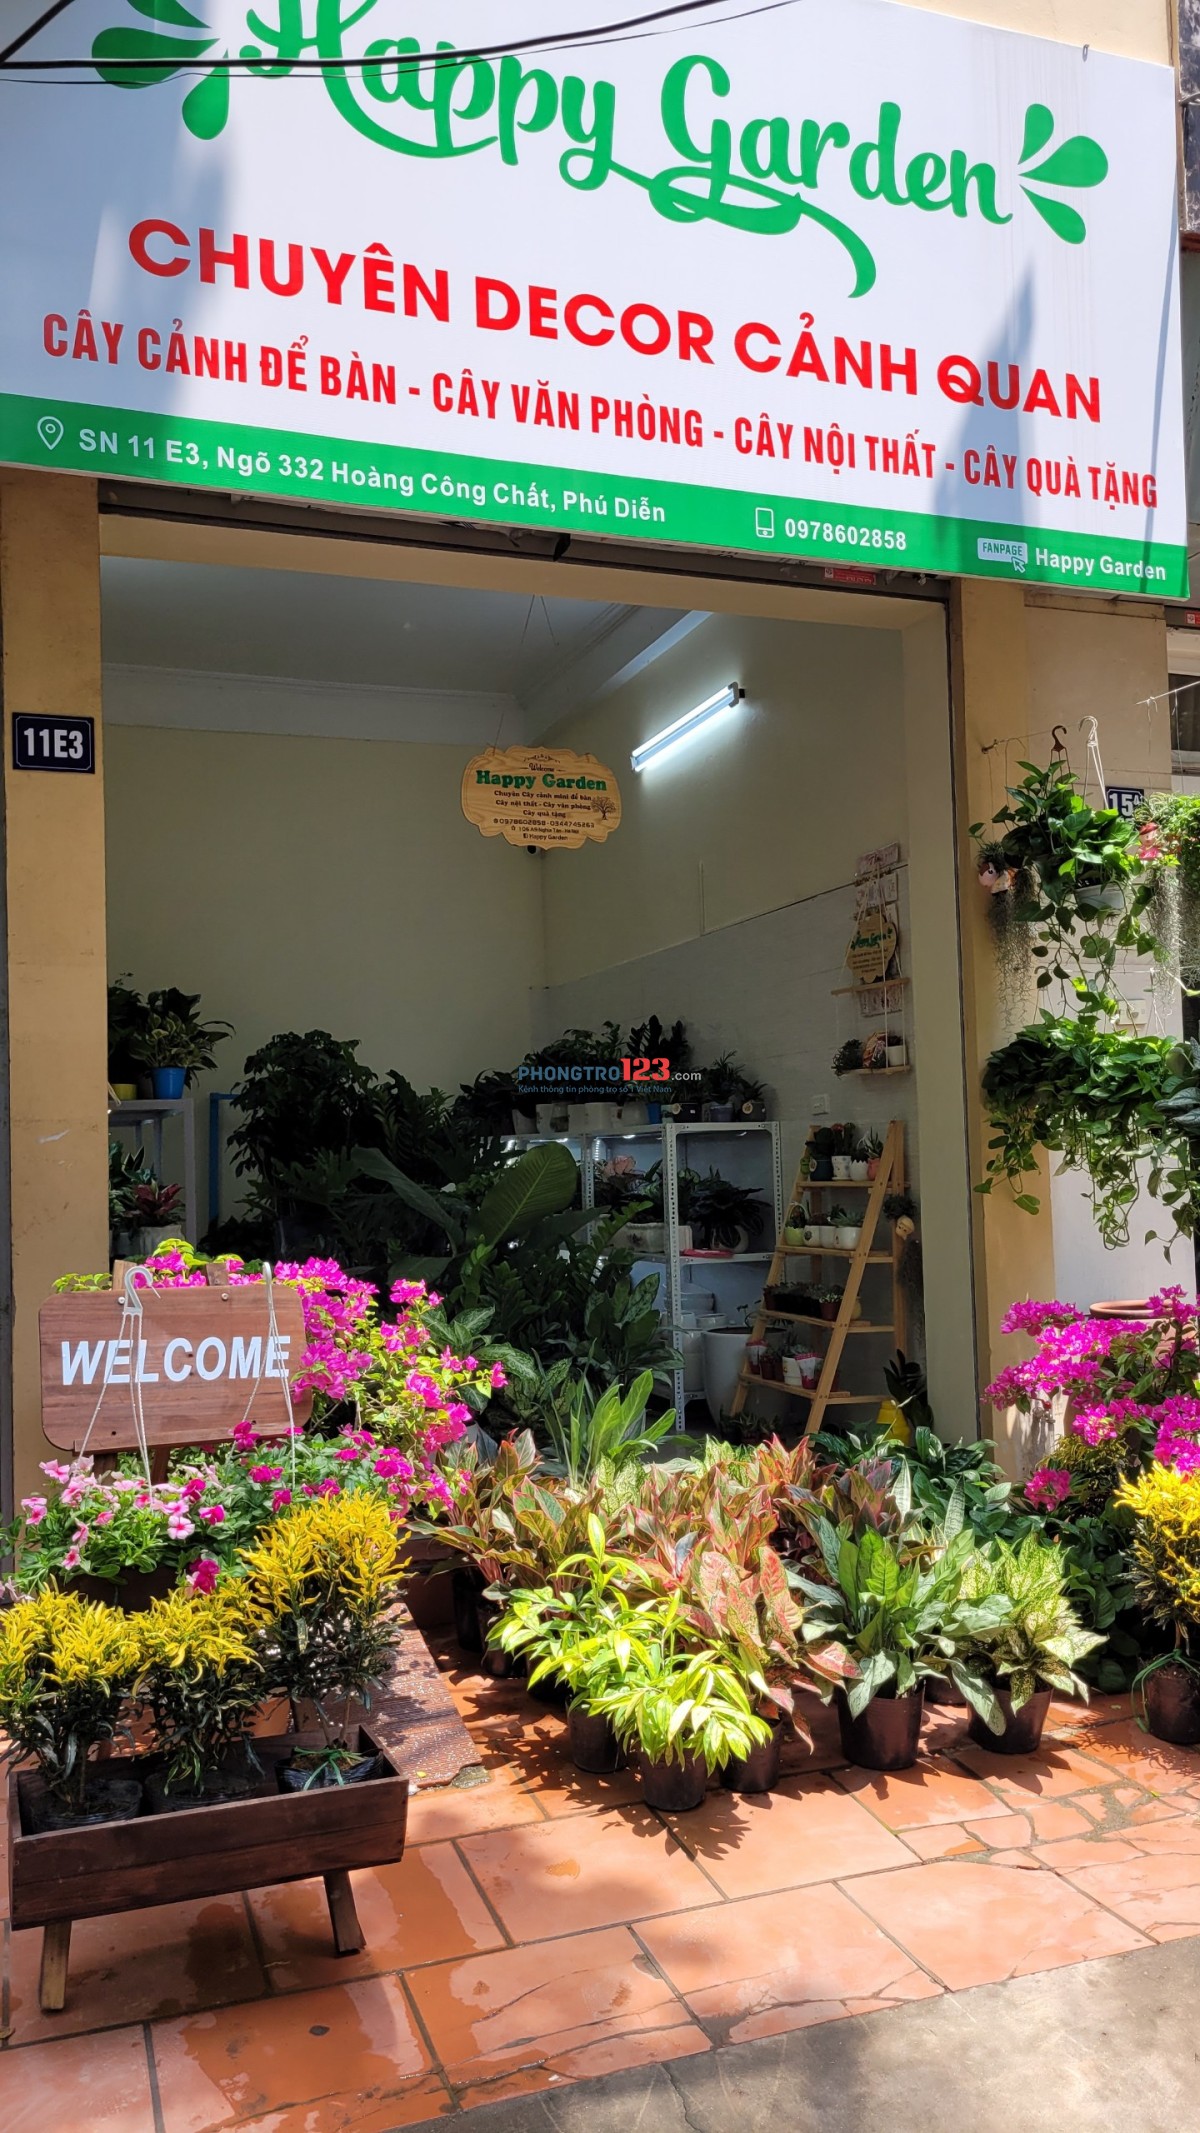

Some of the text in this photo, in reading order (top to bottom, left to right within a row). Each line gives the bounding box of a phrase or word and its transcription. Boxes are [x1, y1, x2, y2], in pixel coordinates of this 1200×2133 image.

[239, 0, 1013, 297] Happy Garden
[129, 219, 1101, 423] CHUYÊN DECOR CẢNH QUAN
[43, 309, 124, 364] CÂY
[138, 317, 247, 383] CẢNH
[260, 335, 309, 392] ĐỂ
[320, 351, 396, 405] BÀN
[432, 368, 500, 419] CÂY
[512, 381, 580, 430] VĂN
[591, 394, 703, 448] PHÒNG
[734, 412, 793, 459] CÂY
[804, 422, 856, 475] NỘI
[864, 429, 936, 479] THẤT
[964, 446, 1017, 489] CÂY
[1026, 455, 1081, 498] QUÀ
[1088, 461, 1158, 509] TẶNG
[79, 428, 665, 523] SN 11 E3, Ngõ 332 Hoàng Công Chất, Phú Diễn
[784, 517, 907, 552] 0978602858
[981, 541, 1024, 559] FANPAGE
[1035, 548, 1167, 580] Happy Garden
[23, 727, 84, 759] 11E3
[476, 770, 607, 791] Happy Garden
[61, 1335, 291, 1386] WELCOME
